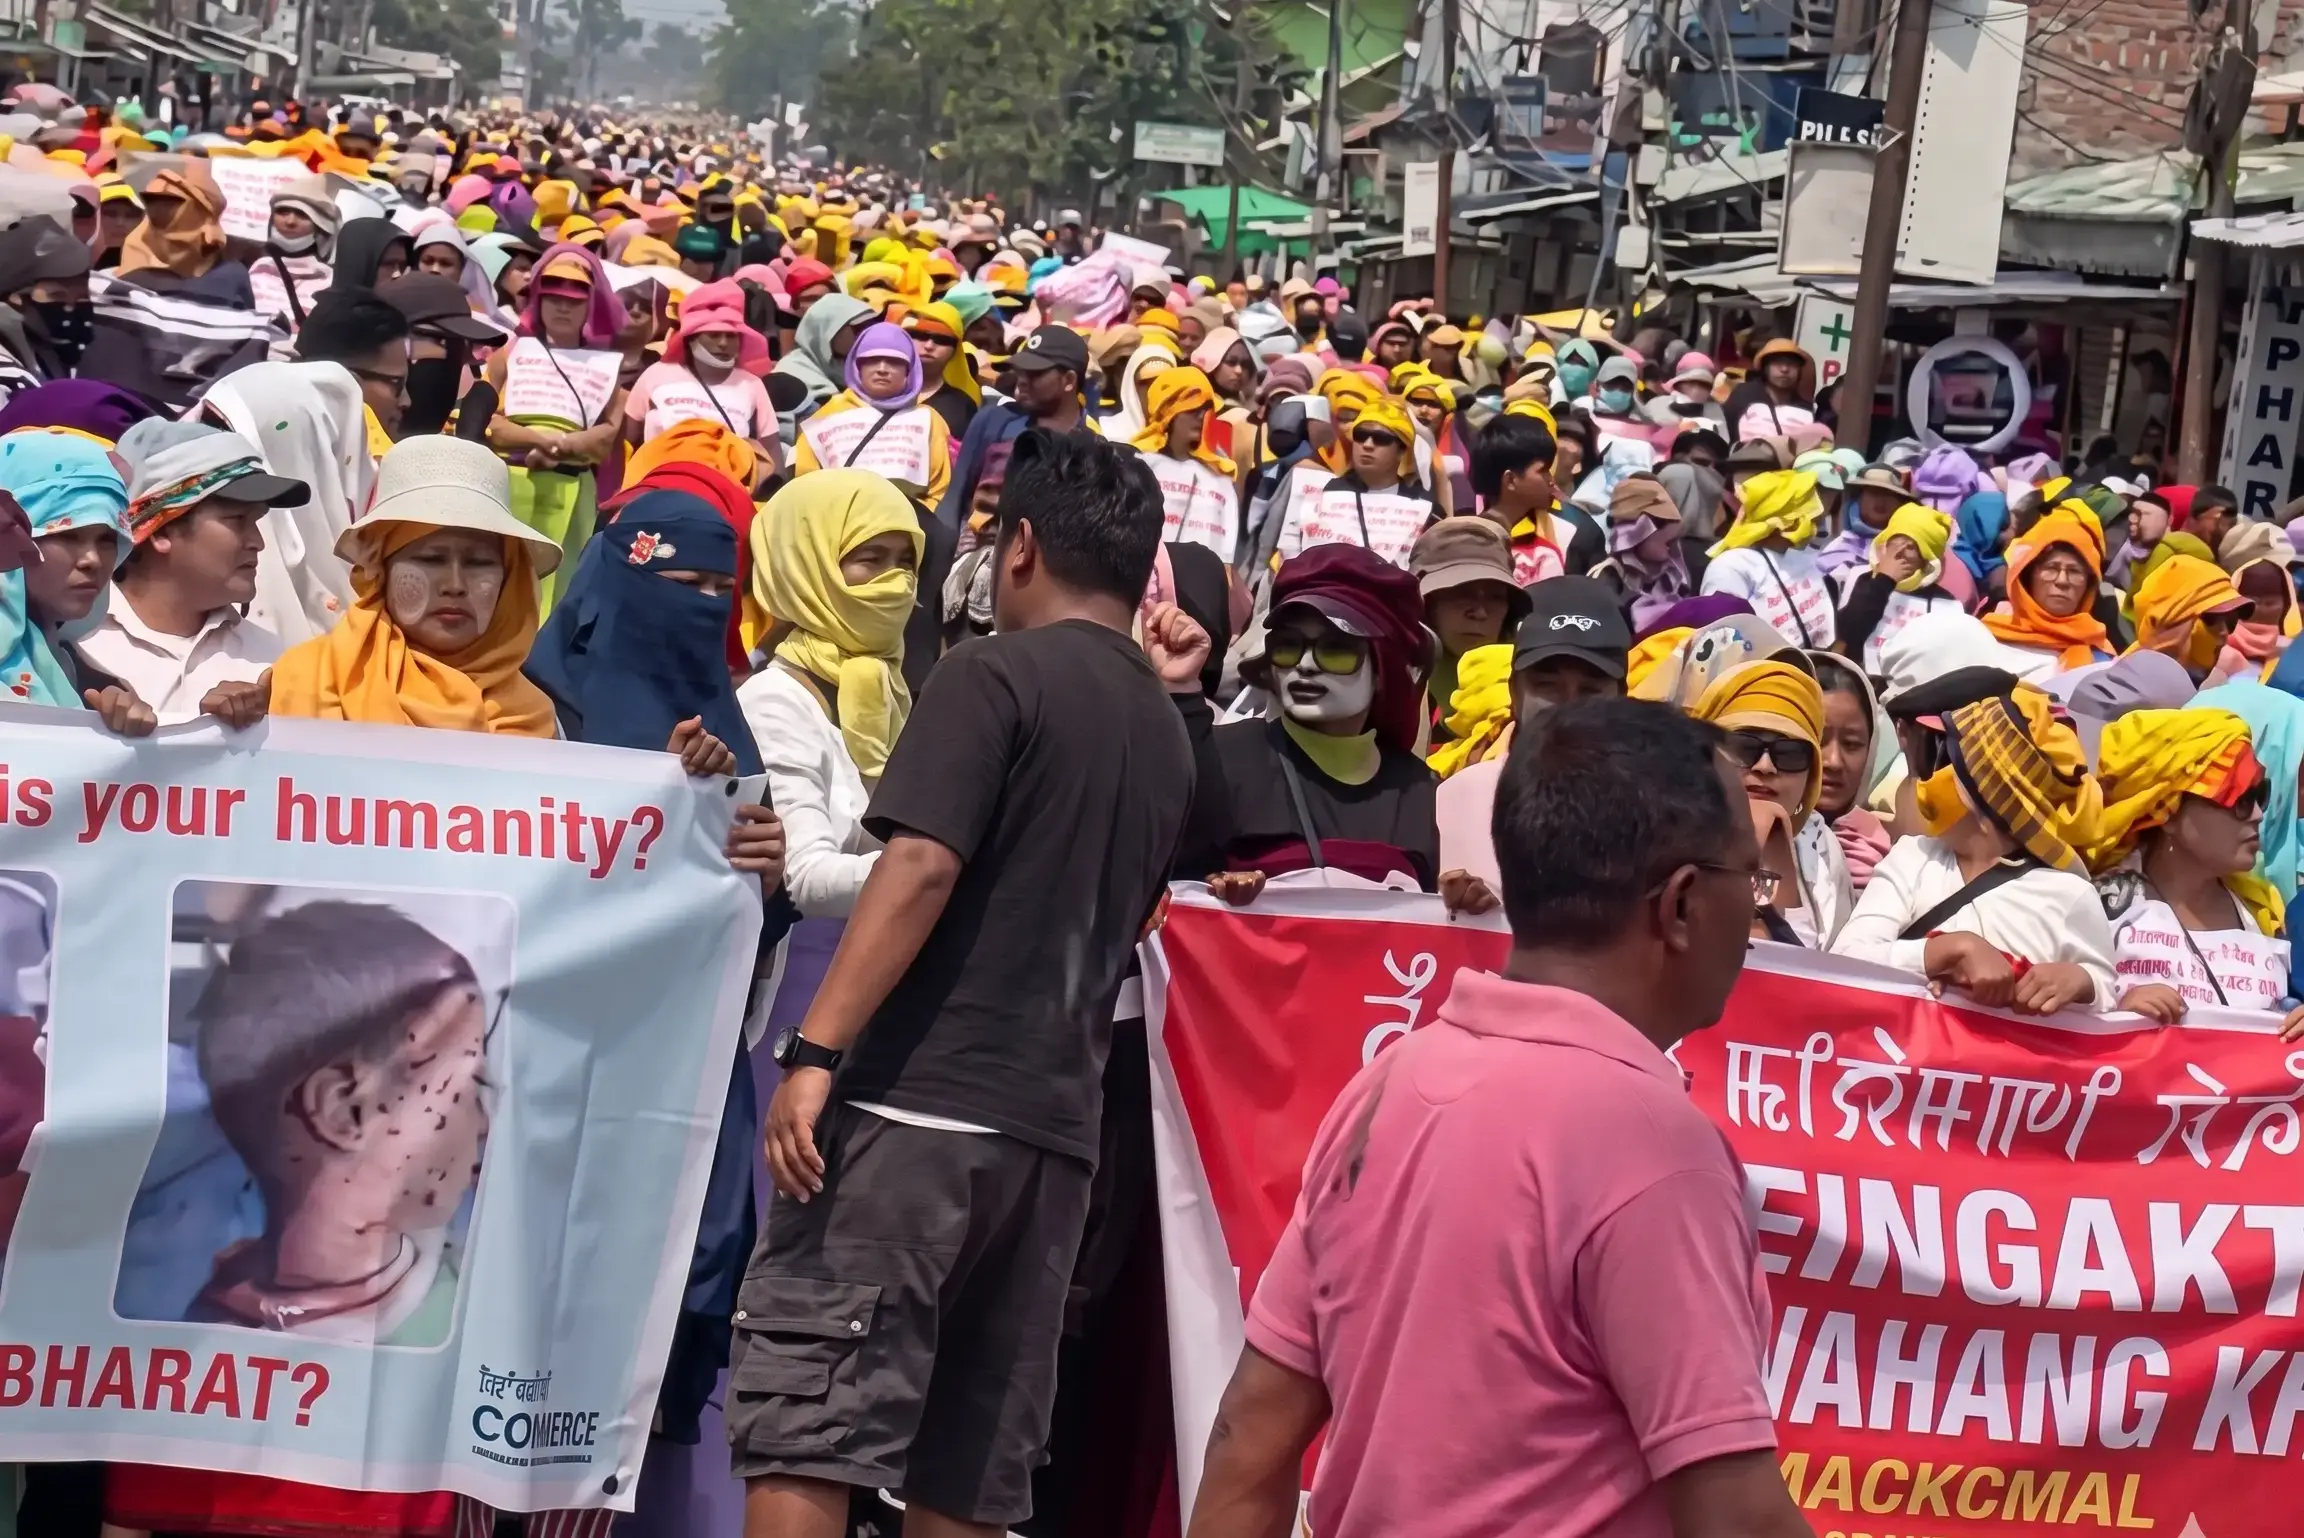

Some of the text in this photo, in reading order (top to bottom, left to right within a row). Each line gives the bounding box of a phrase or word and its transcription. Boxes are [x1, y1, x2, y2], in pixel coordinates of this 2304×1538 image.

[0, 763, 665, 880] is your humanity?
[0, 1344, 330, 1427] BHARAT?
